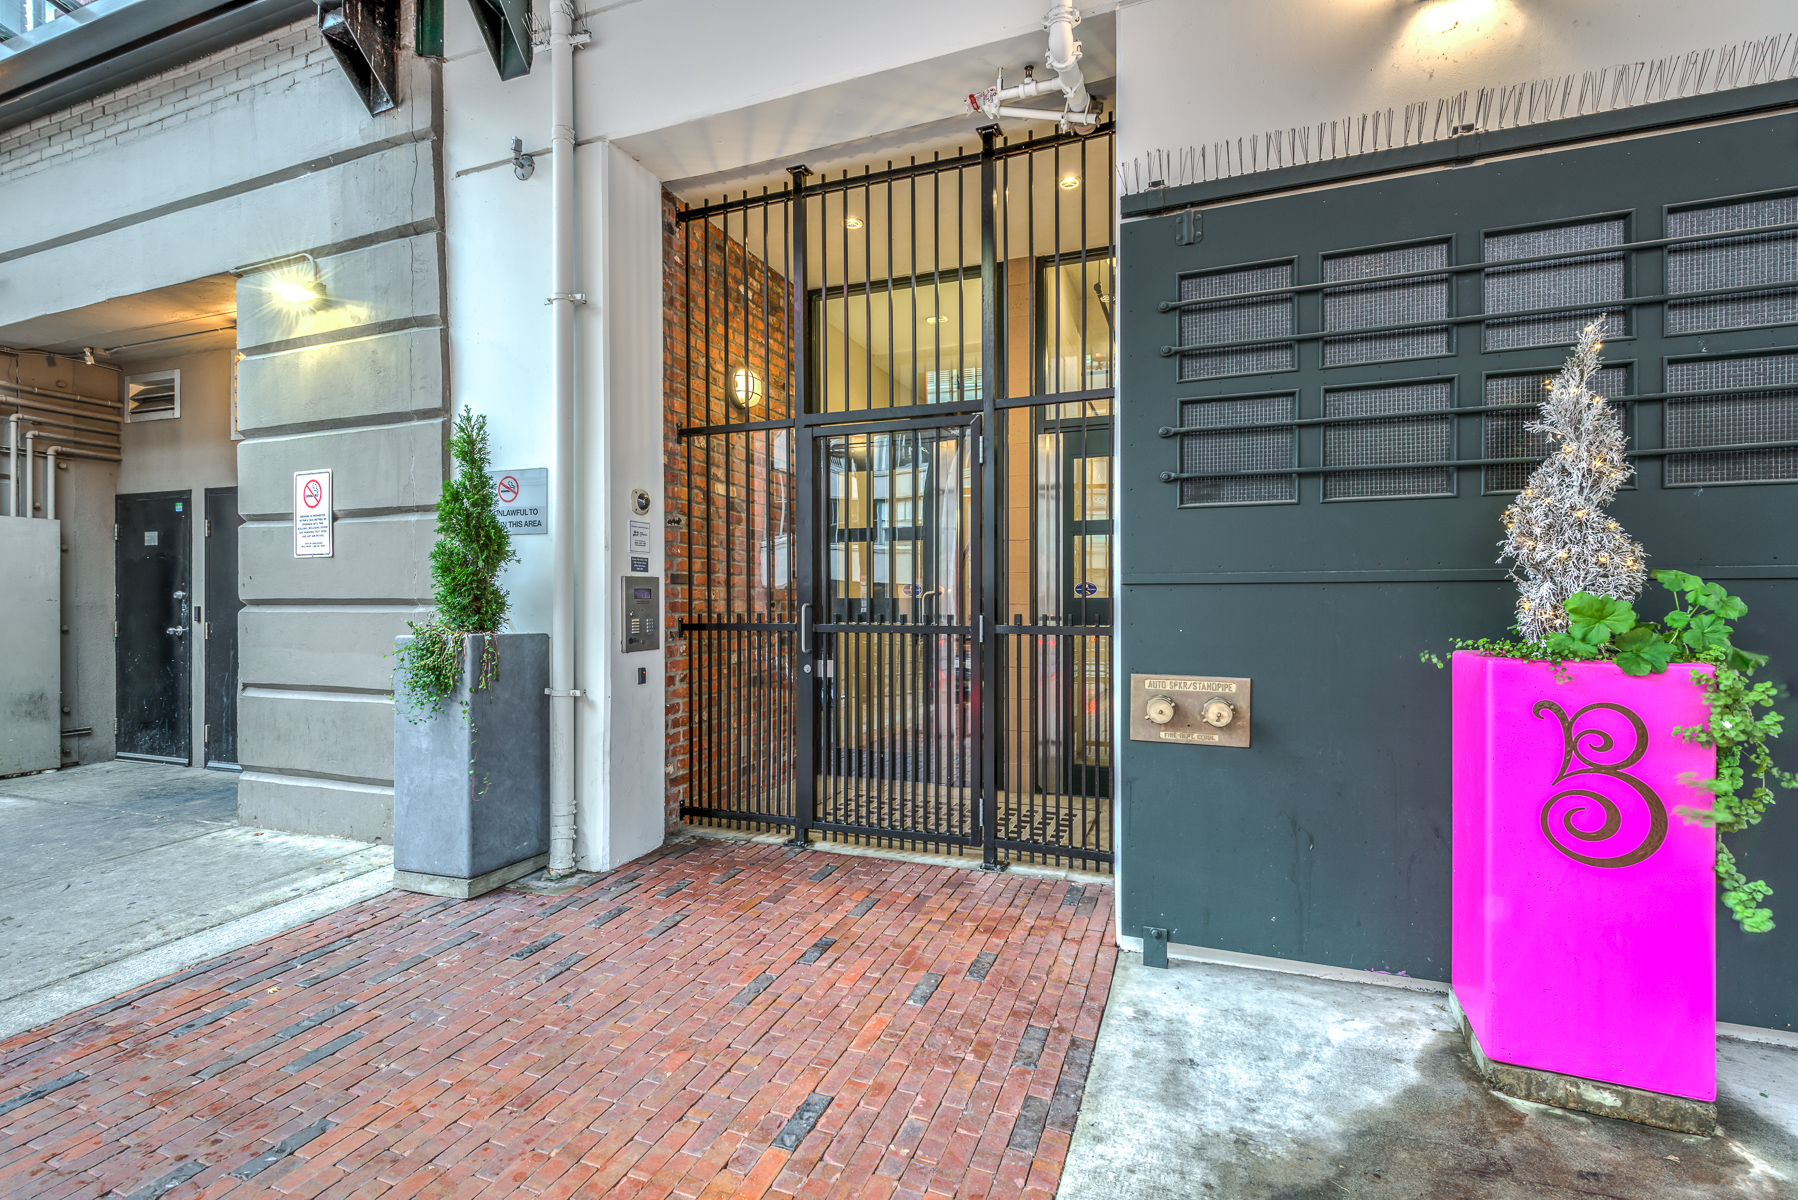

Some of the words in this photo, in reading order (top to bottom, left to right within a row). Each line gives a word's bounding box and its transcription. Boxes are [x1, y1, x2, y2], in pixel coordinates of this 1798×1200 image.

[528, 508, 539, 516] TO
[508, 520, 523, 528] THIS
[524, 520, 542, 528] AREA
[1148, 680, 1167, 689] AUTO
[1533, 700, 1668, 868] B
